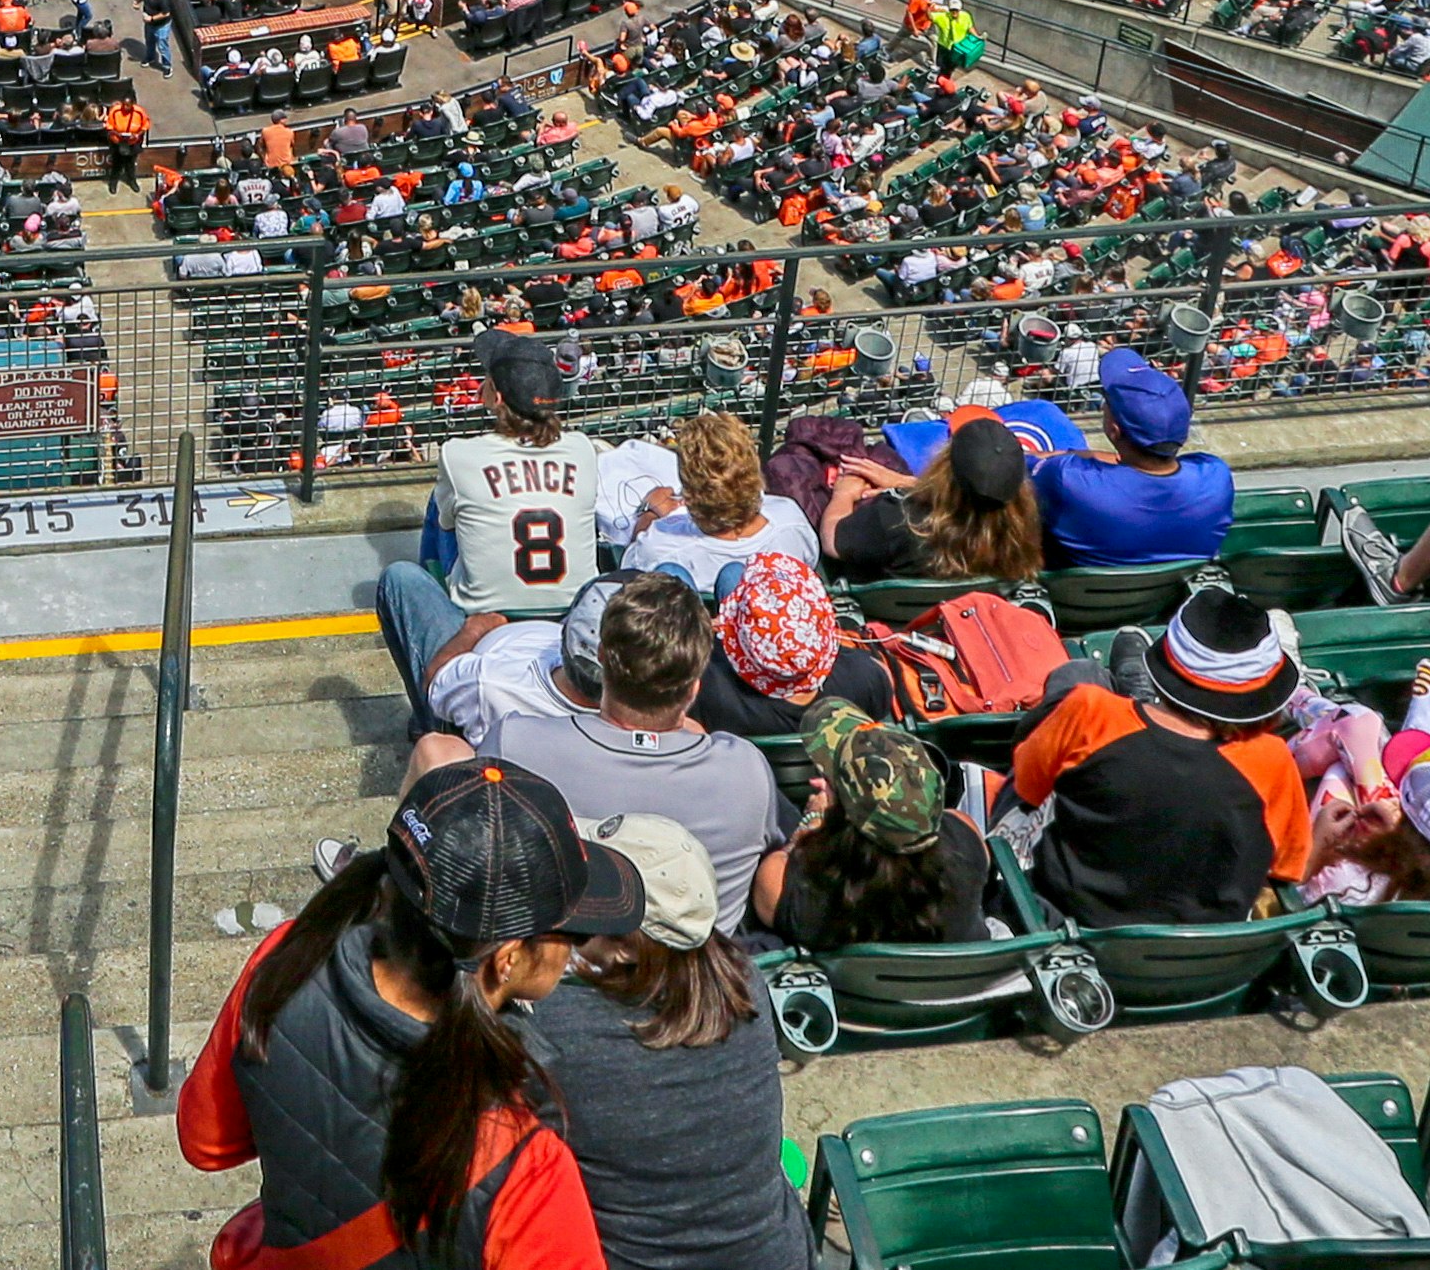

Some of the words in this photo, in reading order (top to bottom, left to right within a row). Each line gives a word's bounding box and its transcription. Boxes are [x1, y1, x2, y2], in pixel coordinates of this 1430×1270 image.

[0, 368, 73, 385] PLEASE
[14, 387, 30, 398] DO
[33, 385, 61, 396] NOT
[7, 411, 23, 420] OR
[26, 408, 65, 419] STAND
[482, 461, 578, 499] PENCE
[118, 486, 209, 529] 314
[511, 508, 567, 585] 8
